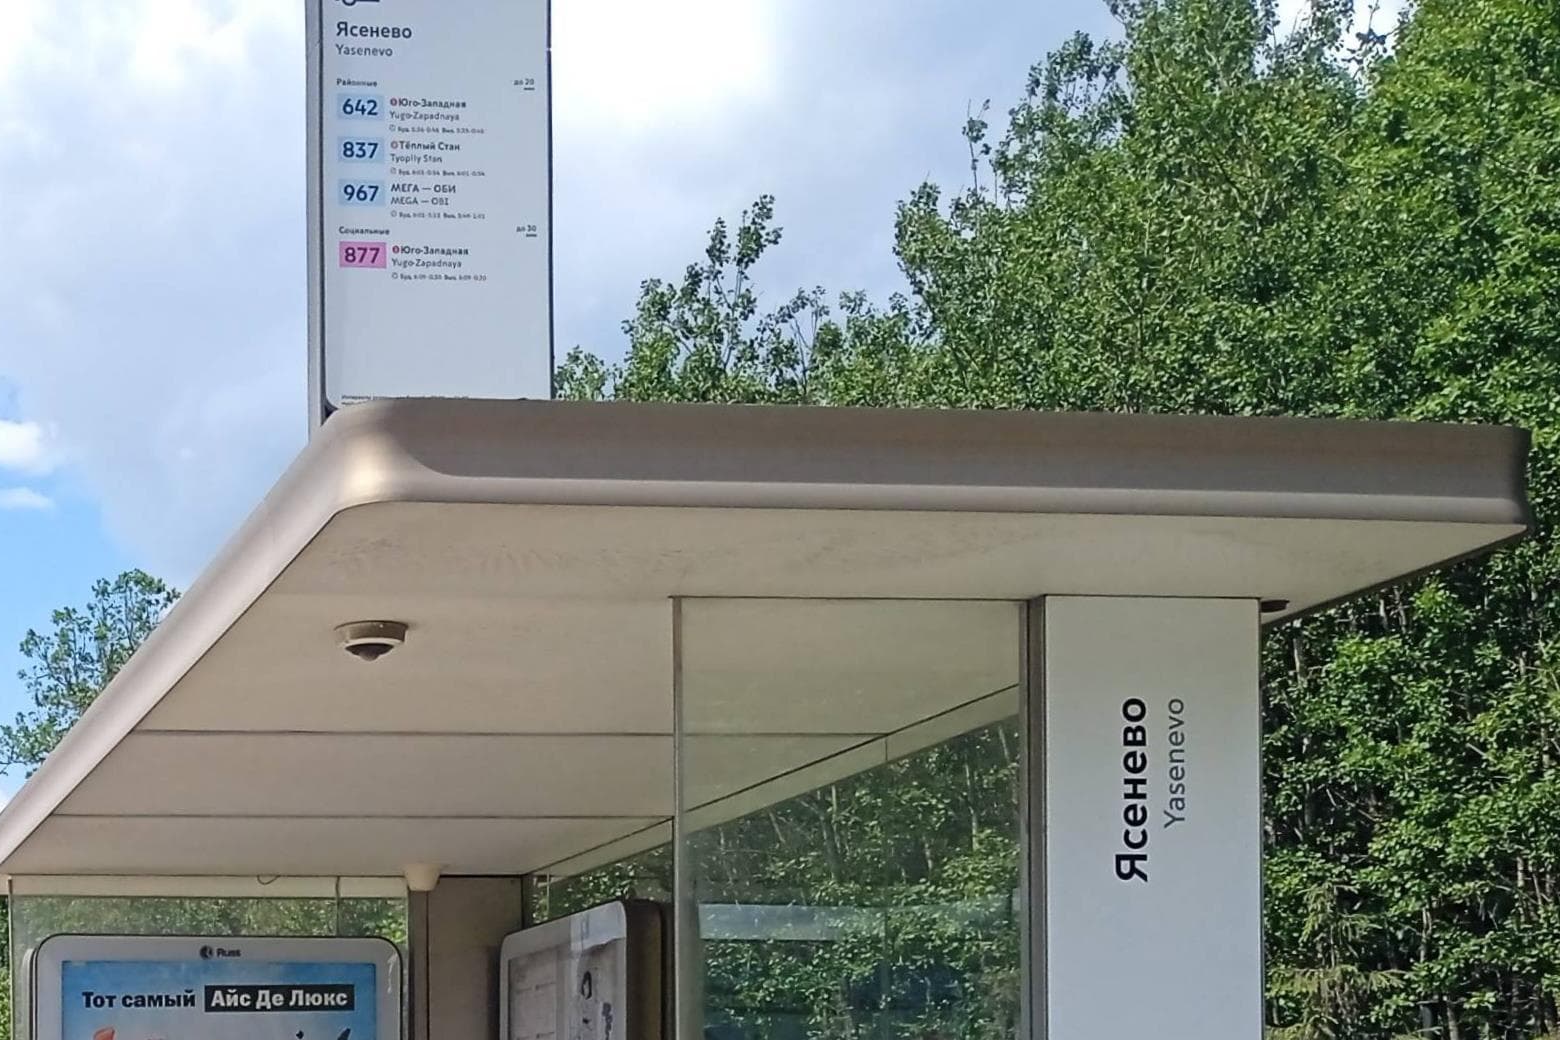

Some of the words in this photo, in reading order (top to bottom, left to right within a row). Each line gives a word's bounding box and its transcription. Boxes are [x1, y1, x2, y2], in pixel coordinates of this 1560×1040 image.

[336, 21, 412, 39] Ясенево
[336, 44, 393, 57] Yasenevo
[342, 98, 378, 116] 642
[398, 98, 467, 109] Юго-Западная
[389, 111, 460, 122] Yugo-Zapadnaya
[342, 141, 379, 159] 837
[399, 140, 436, 150] Тёплый
[437, 141, 460, 151] Стан
[343, 184, 379, 202] 967
[390, 183, 420, 193] МЕГА
[433, 184, 456, 193] ОБИ
[390, 196, 419, 205] MEGA
[344, 247, 380, 264] 877
[400, 245, 469, 256] Юго-Западная
[391, 258, 462, 269] Yugo-Zapadnaya
[1163, 698, 1185, 829] Yasenevo
[1115, 698, 1148, 883] Ясенево
[81, 991, 116, 1008] Тот
[121, 989, 196, 1008] самый
[210, 988, 251, 1007] Айс
[255, 989, 284, 1010] Де
[289, 989, 349, 1007] Люкс
